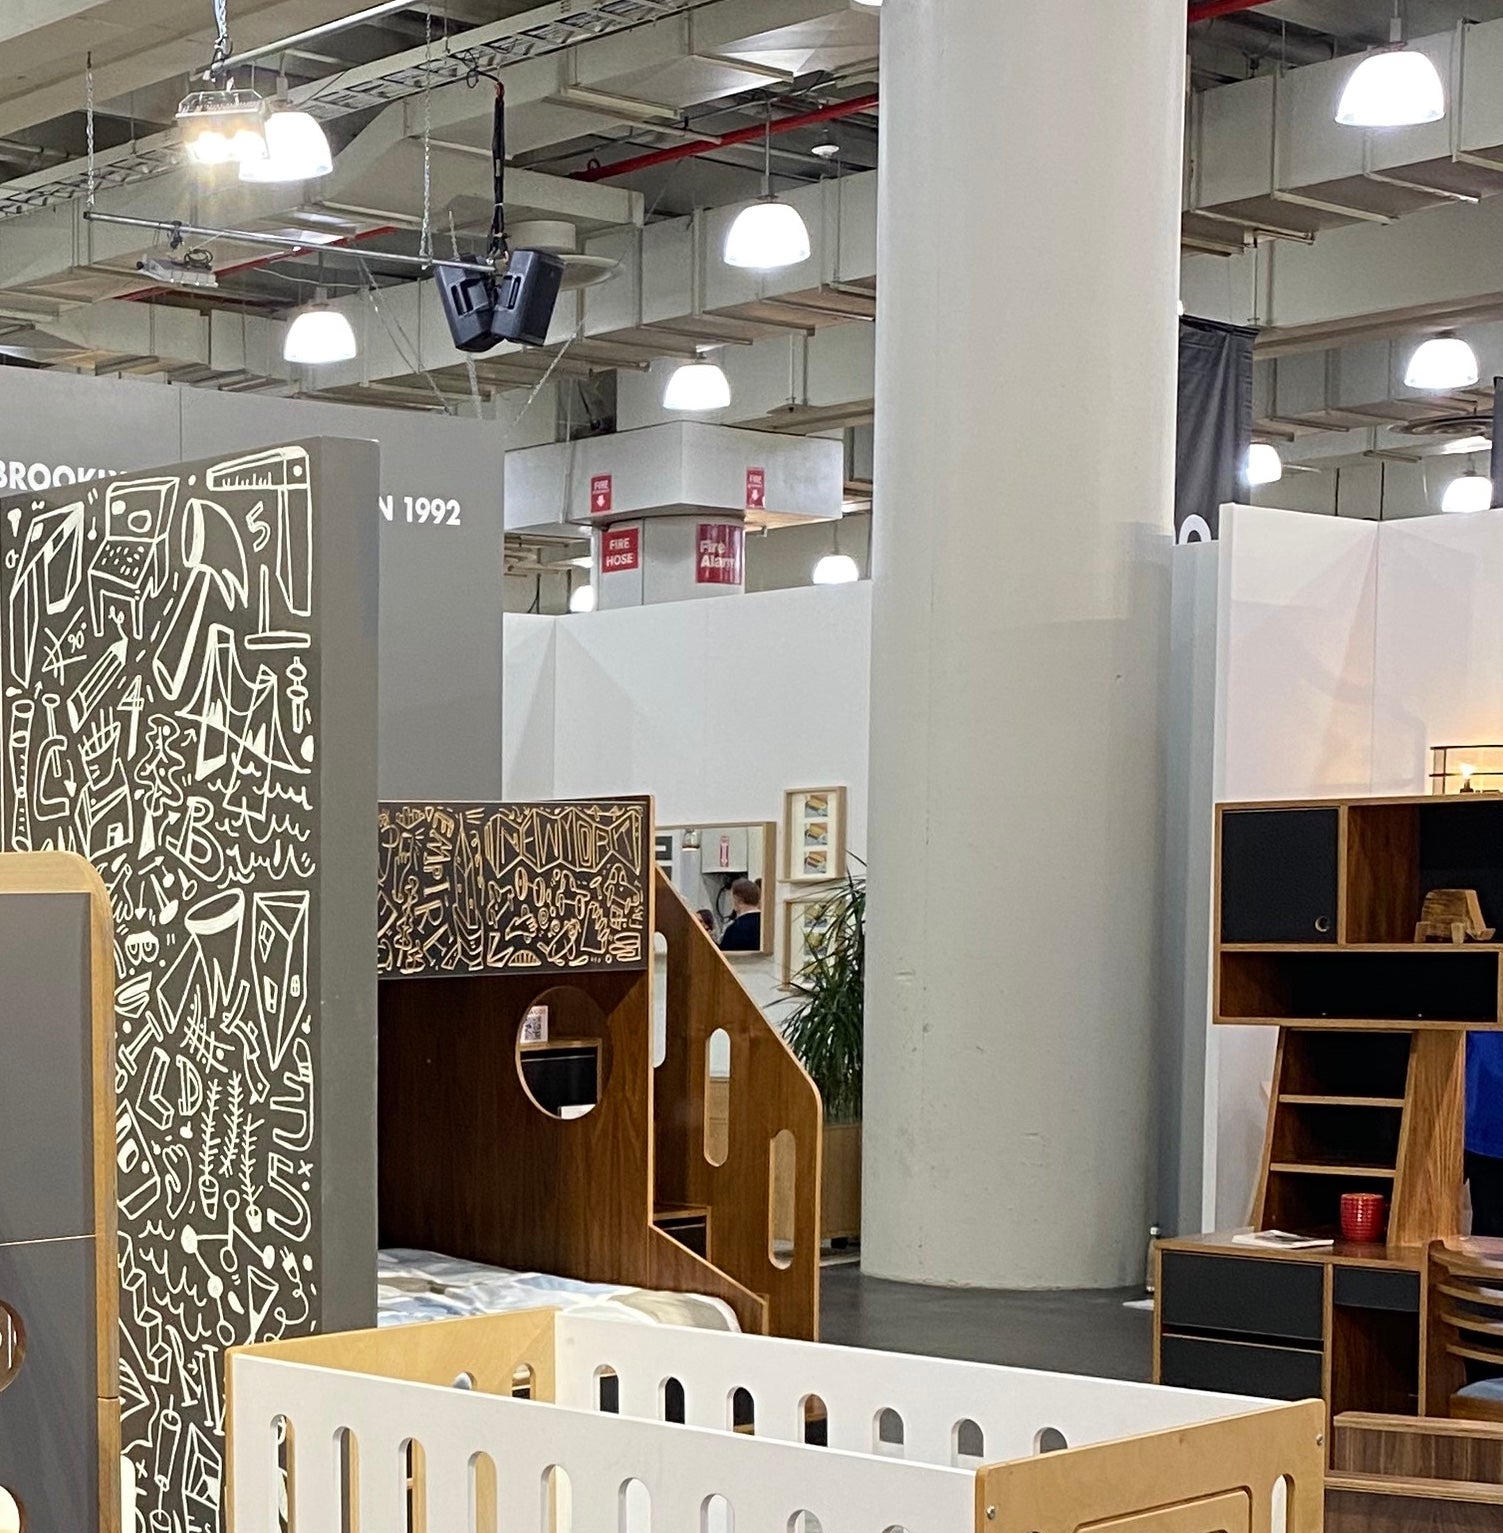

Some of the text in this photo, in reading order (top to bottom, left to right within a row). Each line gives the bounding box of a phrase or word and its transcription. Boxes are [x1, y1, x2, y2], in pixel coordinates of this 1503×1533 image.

[403, 496, 461, 526] 1992
[609, 537, 631, 550] FIRE
[699, 539, 727, 554] Fire
[605, 554, 634, 568] HOSE
[700, 554, 737, 569] Alarm
